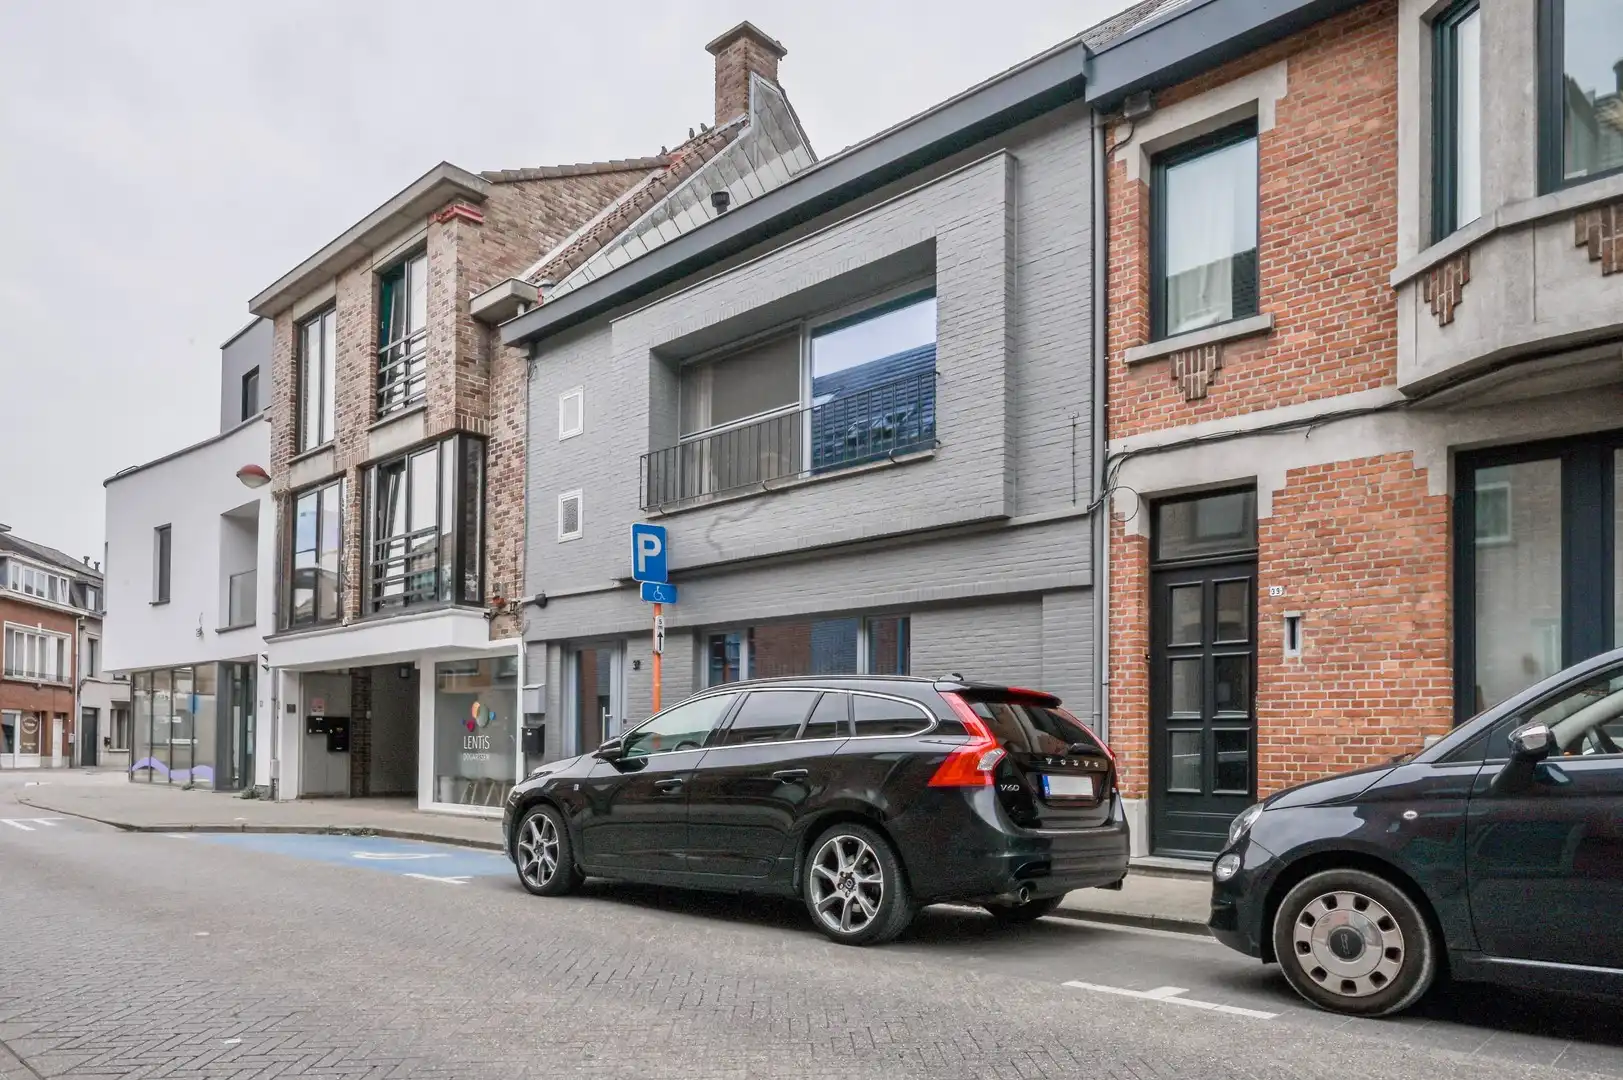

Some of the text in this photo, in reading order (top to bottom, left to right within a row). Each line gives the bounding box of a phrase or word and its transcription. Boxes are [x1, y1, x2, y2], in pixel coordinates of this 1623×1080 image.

[637, 532, 662, 572] P
[1045, 757, 1099, 768] VOLVO
[1000, 783, 1021, 792] V60
